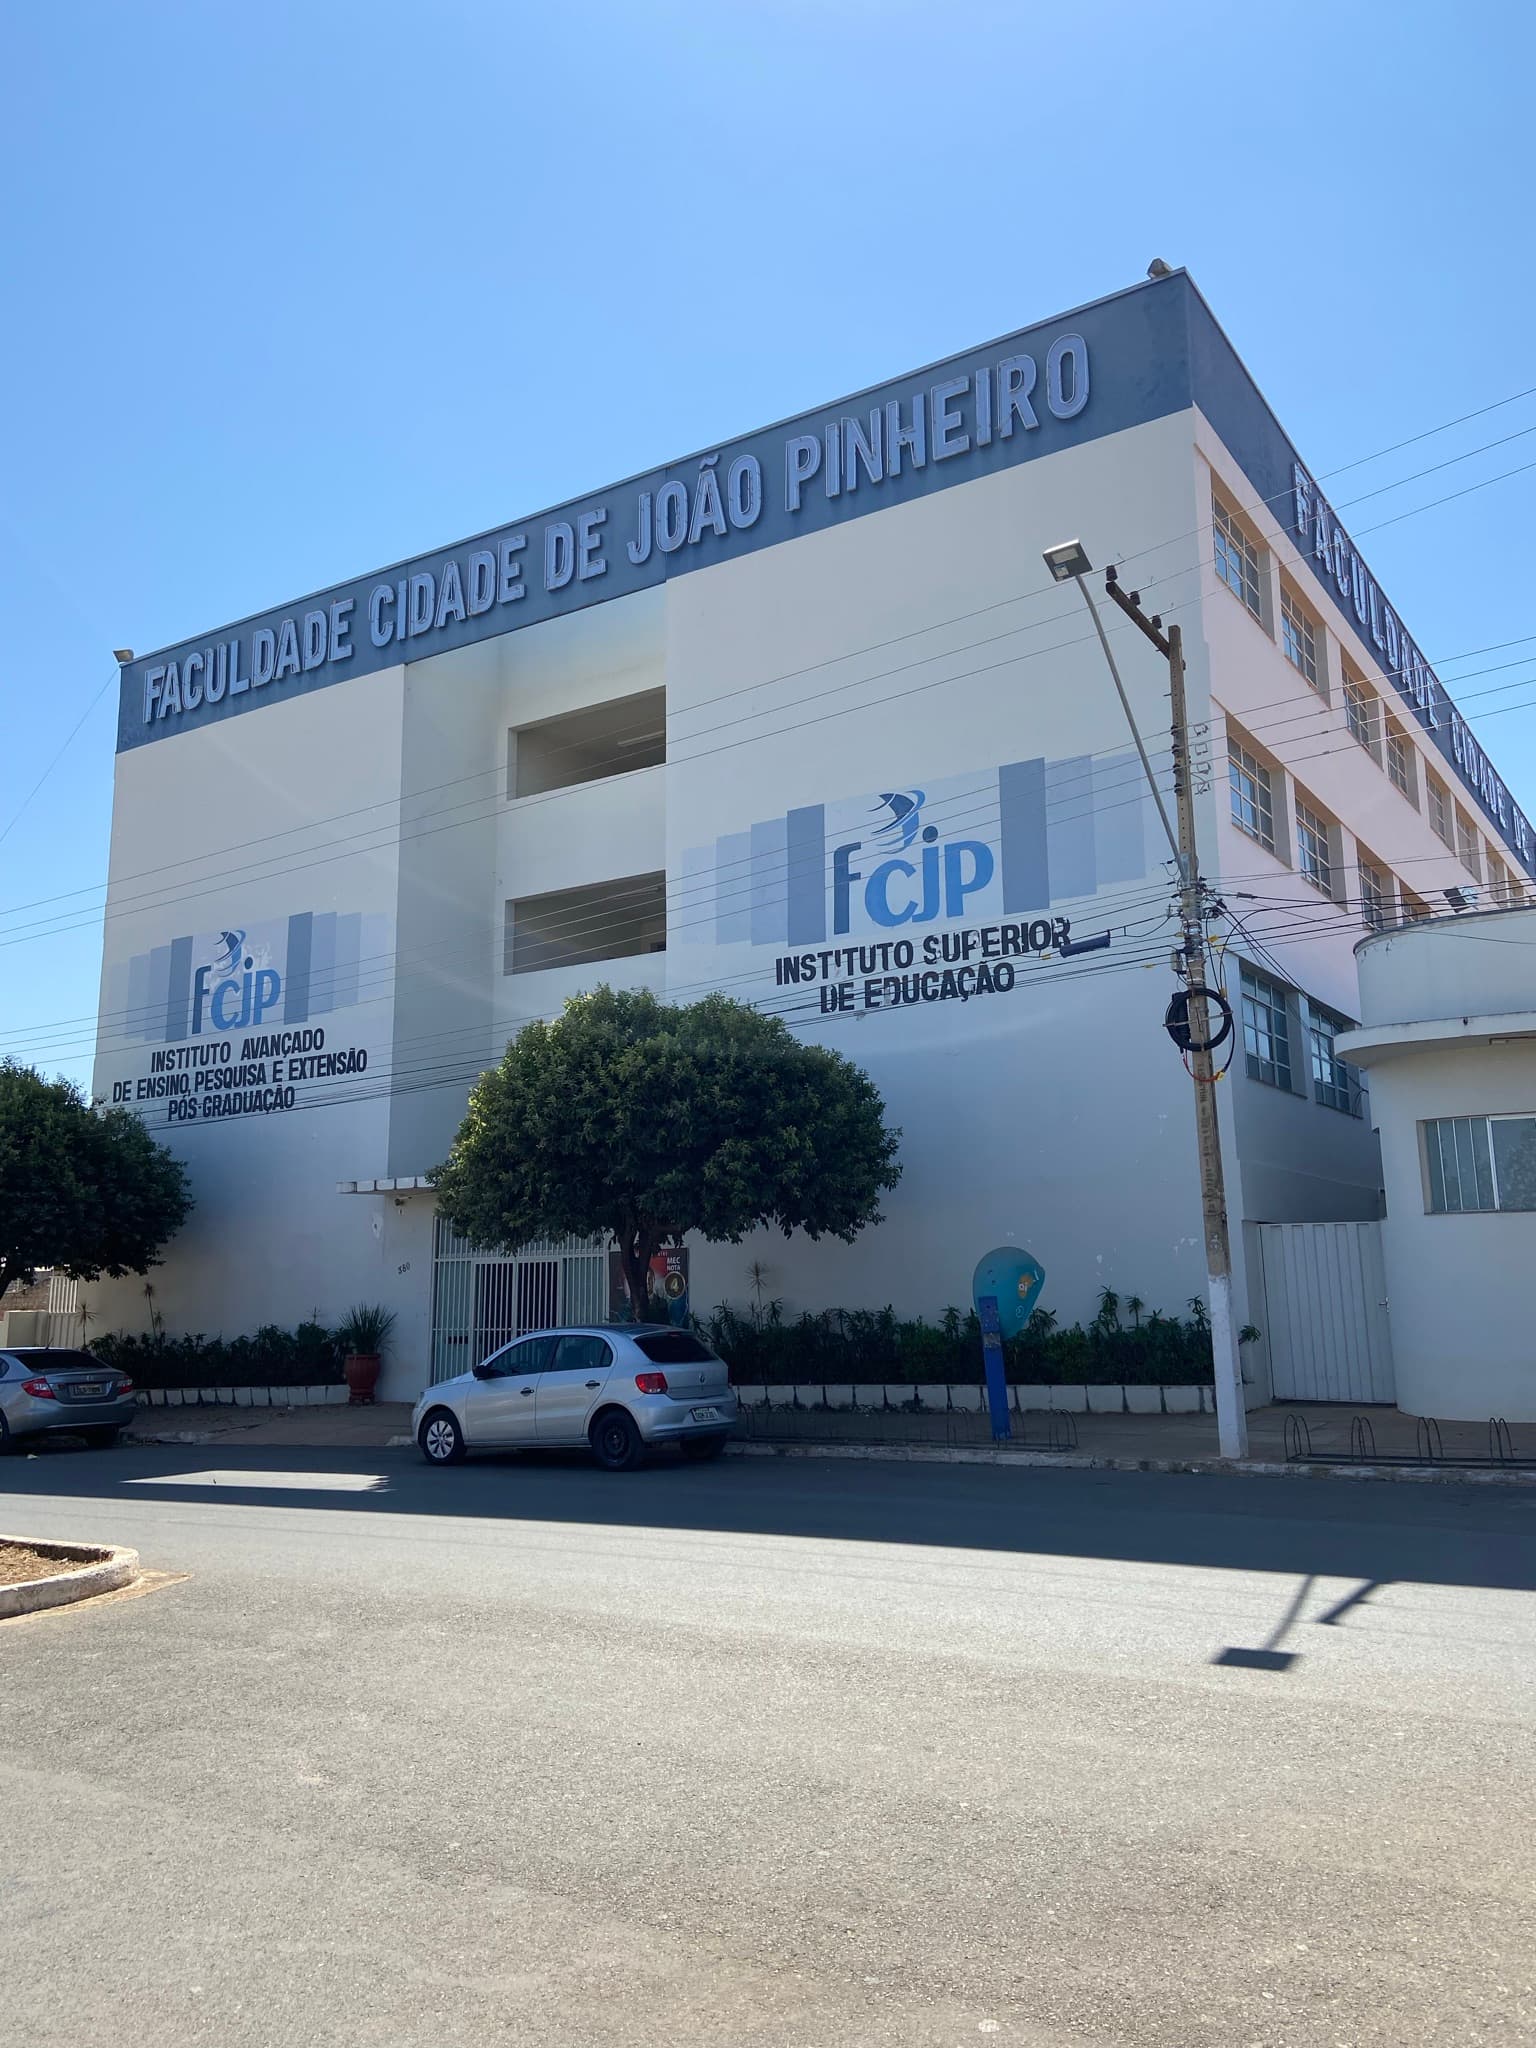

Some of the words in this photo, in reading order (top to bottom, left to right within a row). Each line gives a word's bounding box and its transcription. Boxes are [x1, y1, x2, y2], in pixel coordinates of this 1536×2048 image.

[143, 597, 355, 724] FACULDADE
[368, 535, 528, 648] CIDADE
[544, 507, 608, 591] DE
[626, 451, 763, 565] JOÃO
[784, 333, 1091, 512] PINHEIRO
[1291, 462, 1441, 732] FACULDADE
[775, 939, 914, 986] INSTITUTO
[922, 916, 1072, 965] SUPERIOR
[820, 981, 856, 1014] DE
[863, 960, 1015, 1010] EDUCAÇÃO
[112, 1080, 132, 1104] DE
[193, 1062, 267, 1093] PESQUISA
[271, 1060, 283, 1084] E
[288, 1047, 368, 1082] EXTENSÃO
[151, 1041, 232, 1074] INSTITUTO
[240, 1027, 325, 1061] AVANÇADO
[666, 1256, 681, 1264] MEC
[672, 1278, 679, 1292] 4
